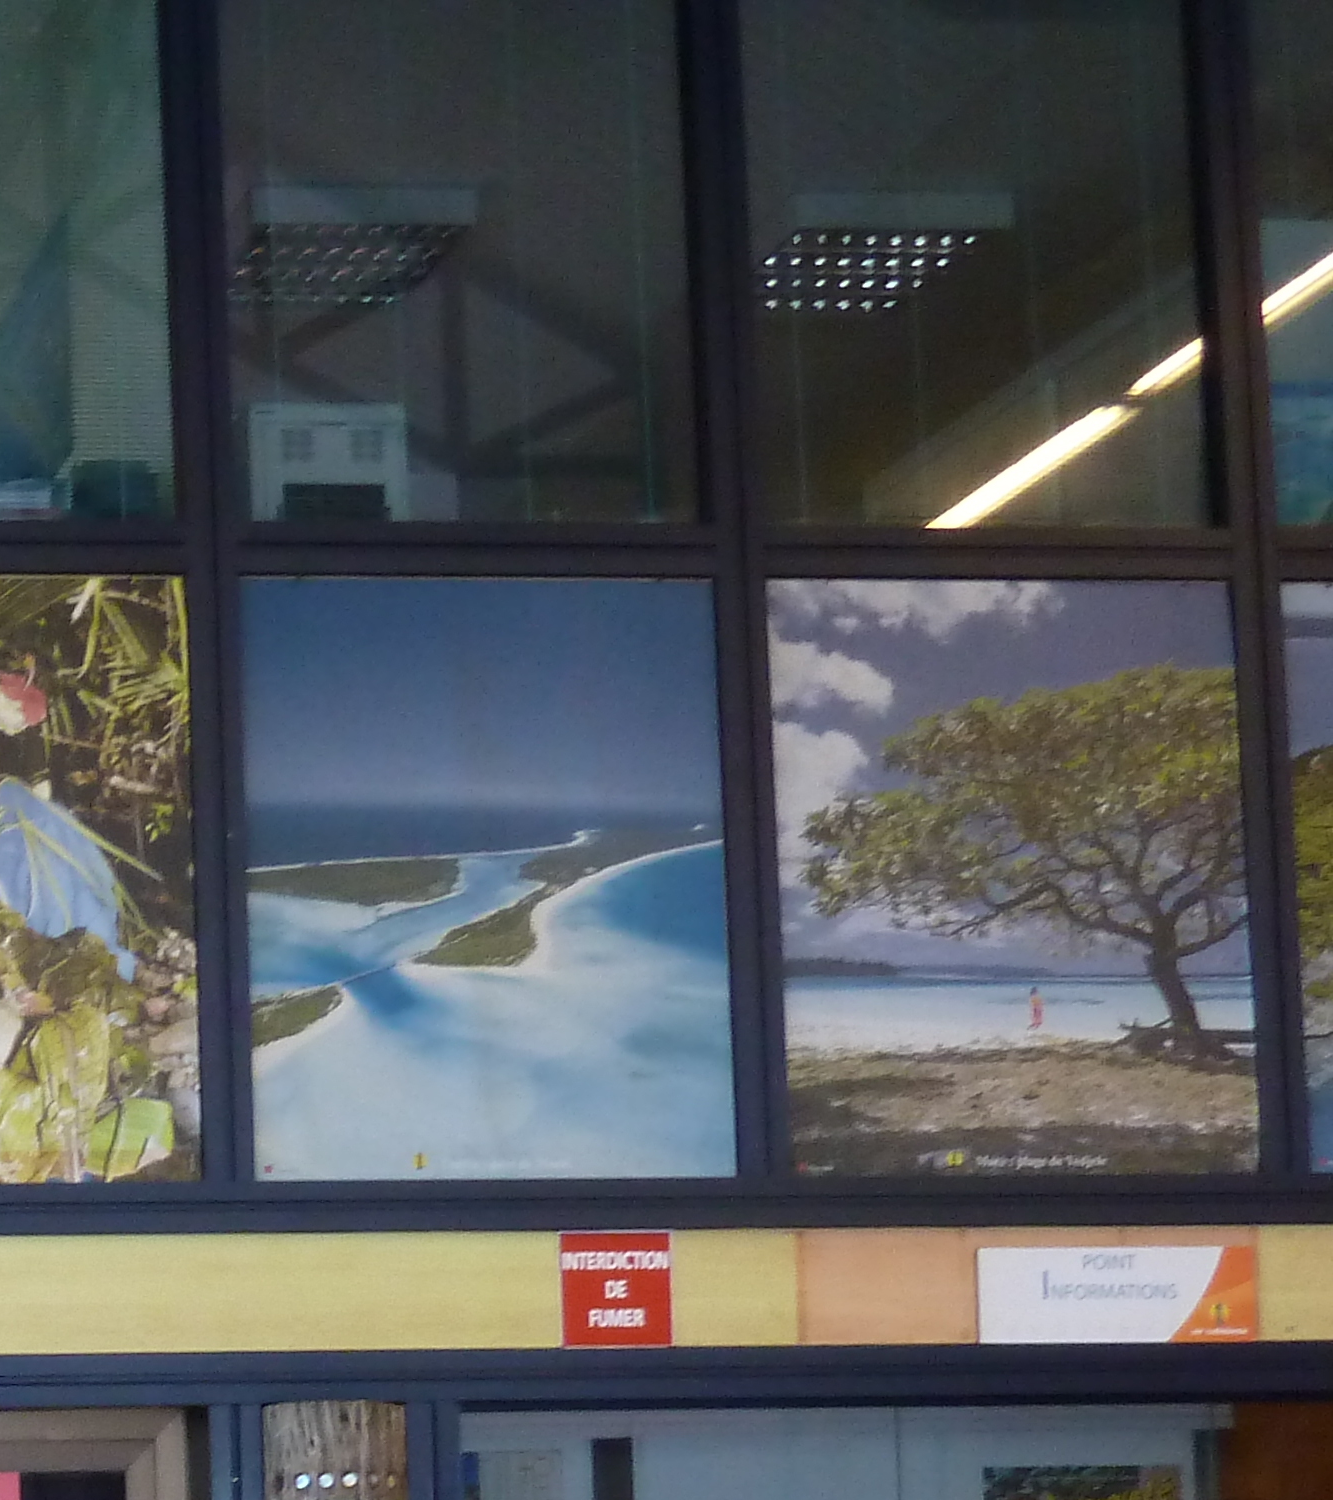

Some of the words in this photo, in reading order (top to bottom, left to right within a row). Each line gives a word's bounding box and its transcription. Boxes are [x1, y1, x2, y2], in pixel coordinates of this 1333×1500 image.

[561, 1250, 669, 1271] INTERDICTION
[1082, 1253, 1136, 1270] POINT
[604, 1279, 629, 1300] DE
[587, 1307, 647, 1329] FUMER
